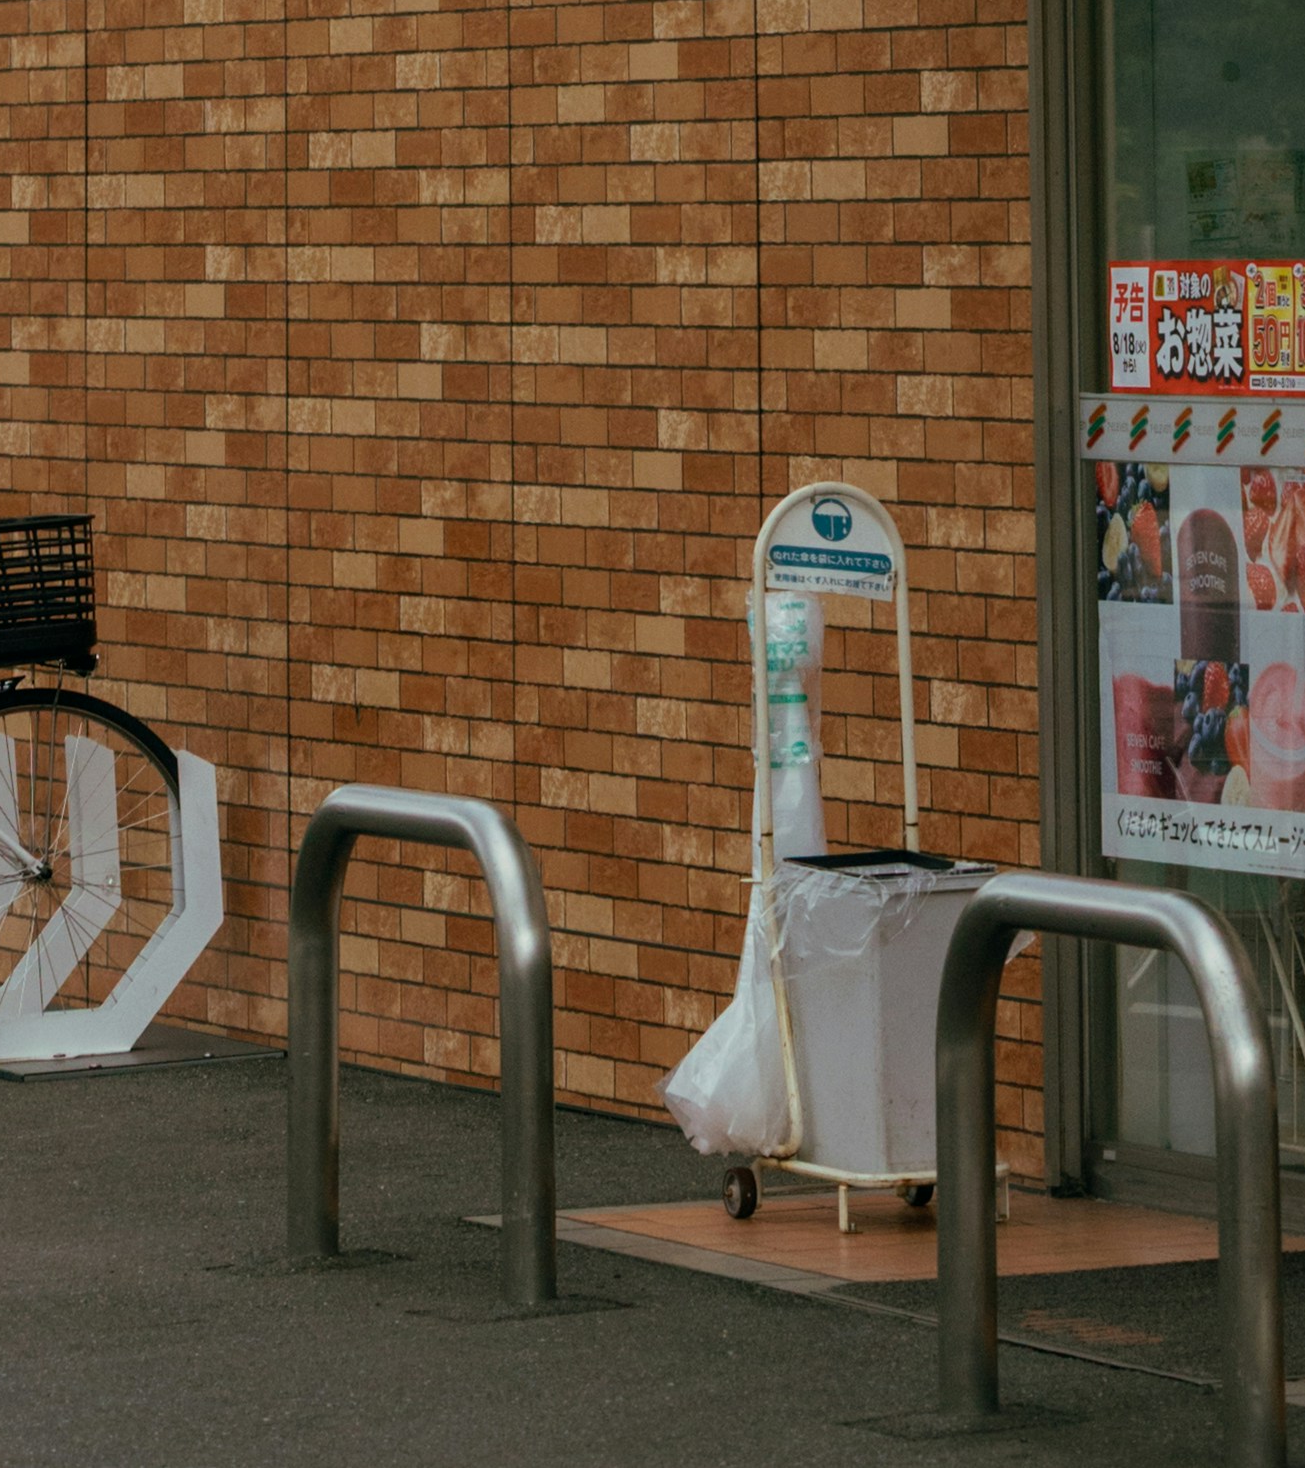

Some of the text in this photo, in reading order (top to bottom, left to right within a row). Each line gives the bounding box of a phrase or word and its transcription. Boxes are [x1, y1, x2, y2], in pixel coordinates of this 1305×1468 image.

[1179, 271, 1212, 300] 対象の
[1114, 282, 1145, 323] 予告
[1155, 306, 1244, 379] お惣菜
[773, 550, 890, 569] ぬれた傘を袋に入れて下さい
[1189, 574, 1227, 594] SMOOTHIE
[1127, 734, 1146, 748] SEVEN
[1130, 760, 1163, 776] SMOOTHIE
